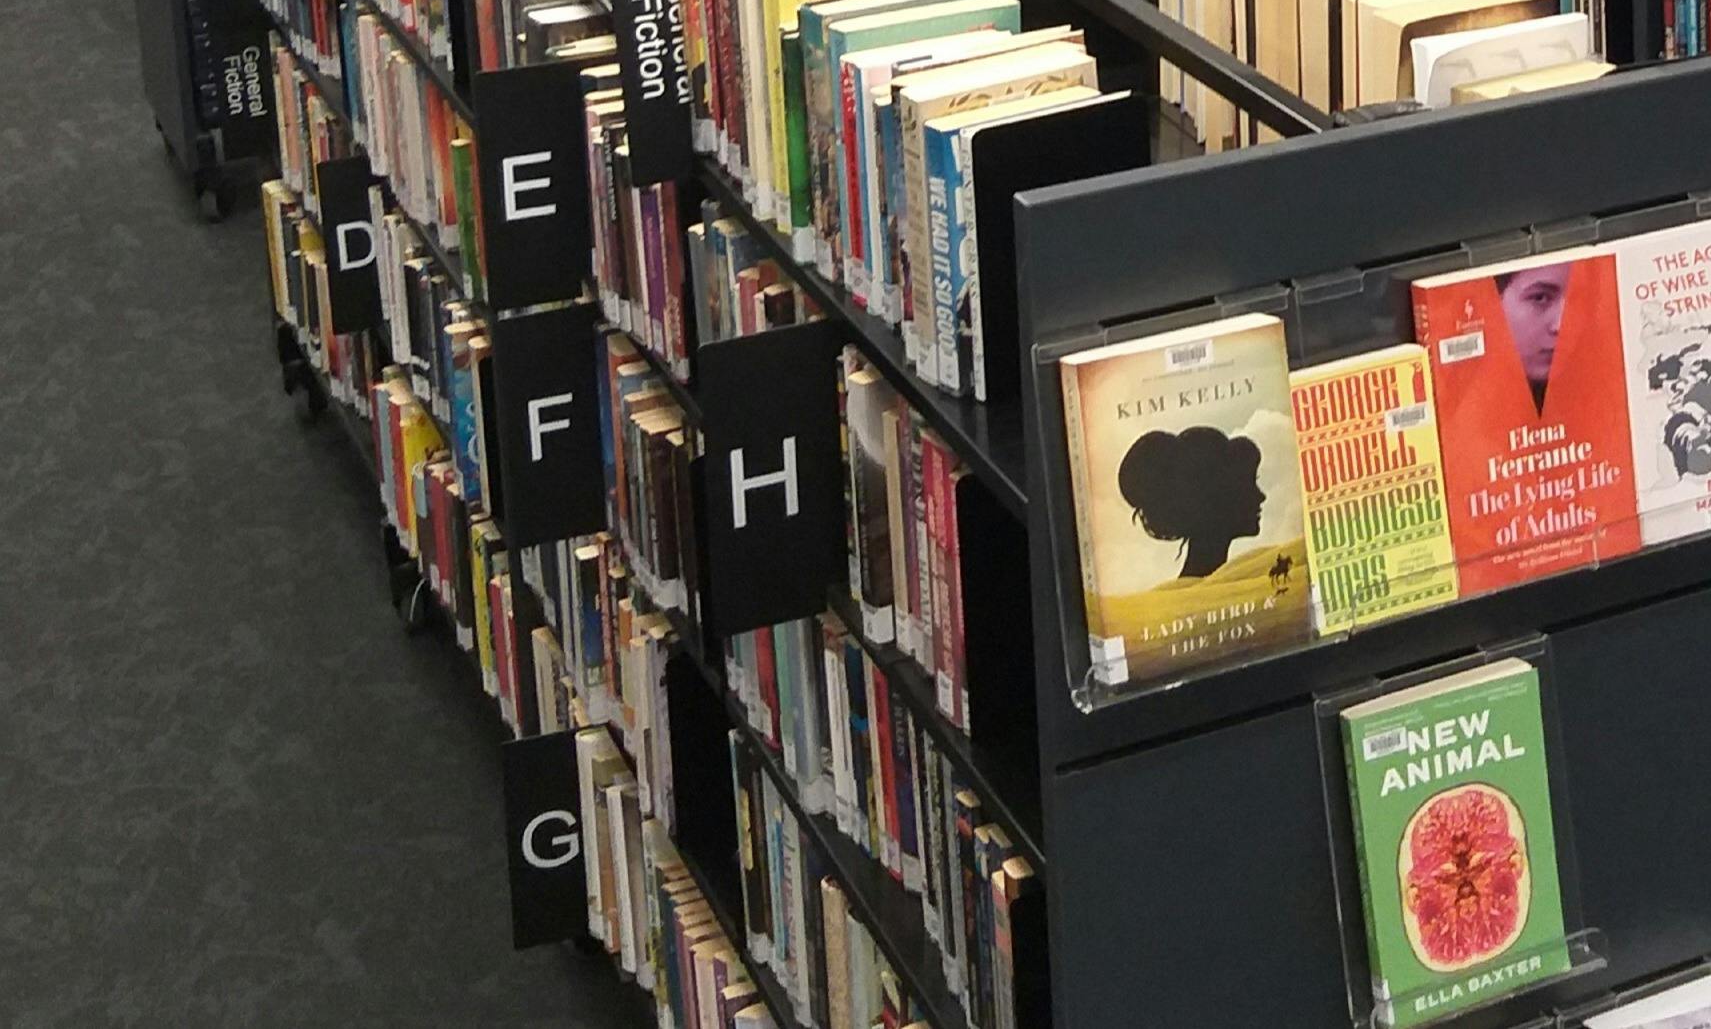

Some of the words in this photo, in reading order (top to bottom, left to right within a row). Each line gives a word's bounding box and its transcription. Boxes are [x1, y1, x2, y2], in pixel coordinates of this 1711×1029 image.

[223, 54, 244, 115] Fiction
[241, 46, 267, 118] General
[502, 150, 557, 222] E
[929, 177, 947, 207] WE
[336, 220, 376, 271] D
[931, 210, 950, 253] HAD
[933, 254, 952, 277] IT
[934, 275, 953, 304] SO
[1634, 282, 1658, 301] OF
[1664, 269, 1709, 295] WIRE
[1653, 254, 1690, 274] THE
[936, 306, 958, 370] GOOD
[1116, 396, 1168, 421] KIM
[1178, 374, 1257, 409] KELLY
[1291, 366, 1401, 433] GEORGE
[527, 391, 574, 462] F
[1508, 423, 1566, 452] Elena
[730, 435, 800, 530] H
[1300, 428, 1417, 493] ORWELL
[1468, 487, 1510, 518] The
[1512, 473, 1575, 511] Lying
[1577, 458, 1621, 489] Life
[1487, 438, 1593, 483] Ferrante
[1309, 478, 1443, 556] BURMESE
[1495, 519, 1519, 548] of
[1521, 504, 1598, 540] Adults
[1319, 551, 1391, 616] DAYS
[1139, 614, 1198, 643] LADY
[1206, 600, 1257, 627] BIRD
[1262, 595, 1277, 610] &
[1169, 636, 1212, 659] THE
[1217, 622, 1257, 647] FOX
[1406, 709, 1491, 756] NEW
[1380, 733, 1526, 797] ANIMAL
[521, 809, 580, 869] G
[1415, 984, 1465, 1015] ELLA
[1468, 954, 1542, 994] BAXTER
